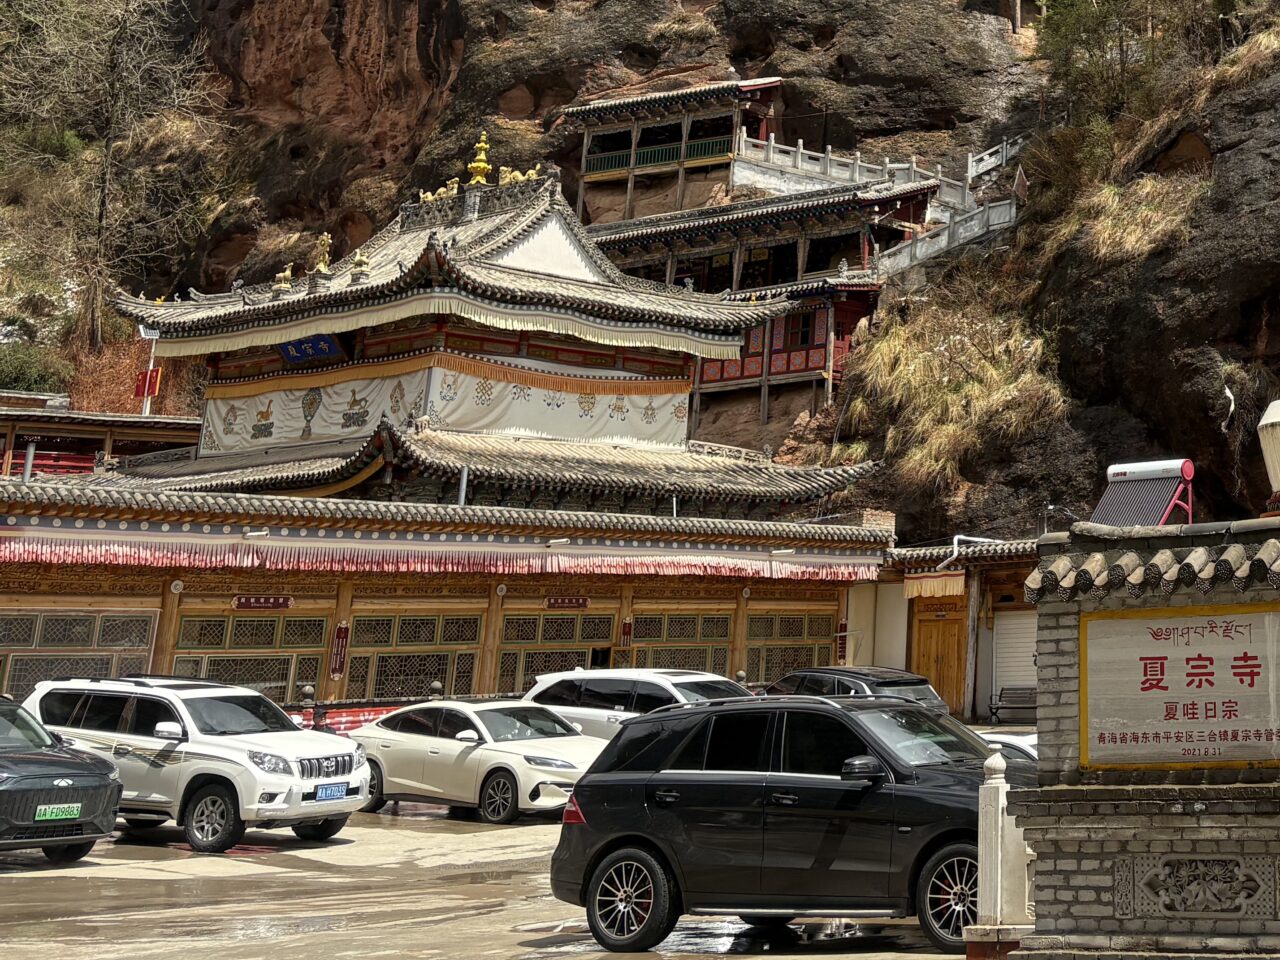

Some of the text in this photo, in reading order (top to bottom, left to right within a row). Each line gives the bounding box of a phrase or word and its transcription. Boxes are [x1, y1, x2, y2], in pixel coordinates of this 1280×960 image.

[1138, 651, 1262, 692] 夏宗寺
[1163, 699, 1239, 721] 夏哇日宗
[1182, 748, 1201, 756] 2021
